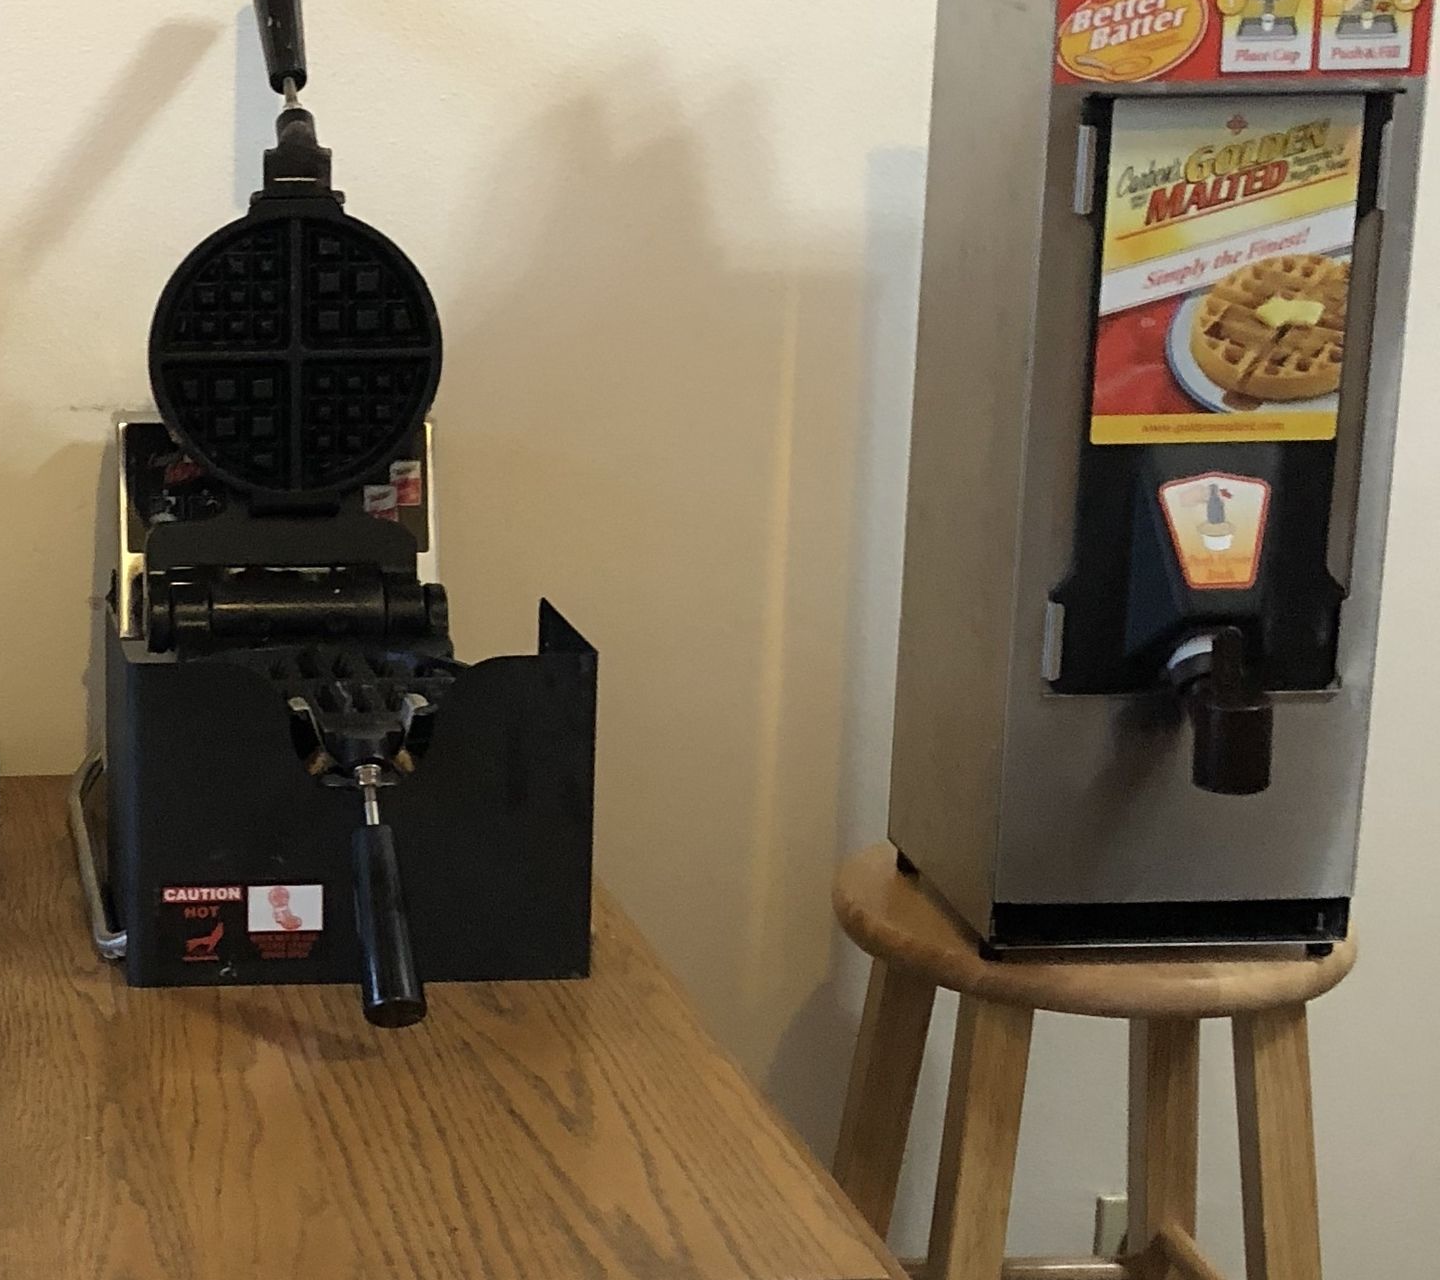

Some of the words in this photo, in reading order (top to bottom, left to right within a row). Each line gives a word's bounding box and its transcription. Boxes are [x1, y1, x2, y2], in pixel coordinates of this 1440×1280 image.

[1090, 6, 1188, 51] Batter
[1184, 118, 1332, 184] GOLDEN
[1144, 159, 1289, 227] MALTED
[1143, 257, 1206, 289] Simply
[1213, 249, 1242, 269] the
[1247, 226, 1312, 259] Finest!
[163, 886, 241, 902] CAUTION
[184, 905, 220, 919] HOT
